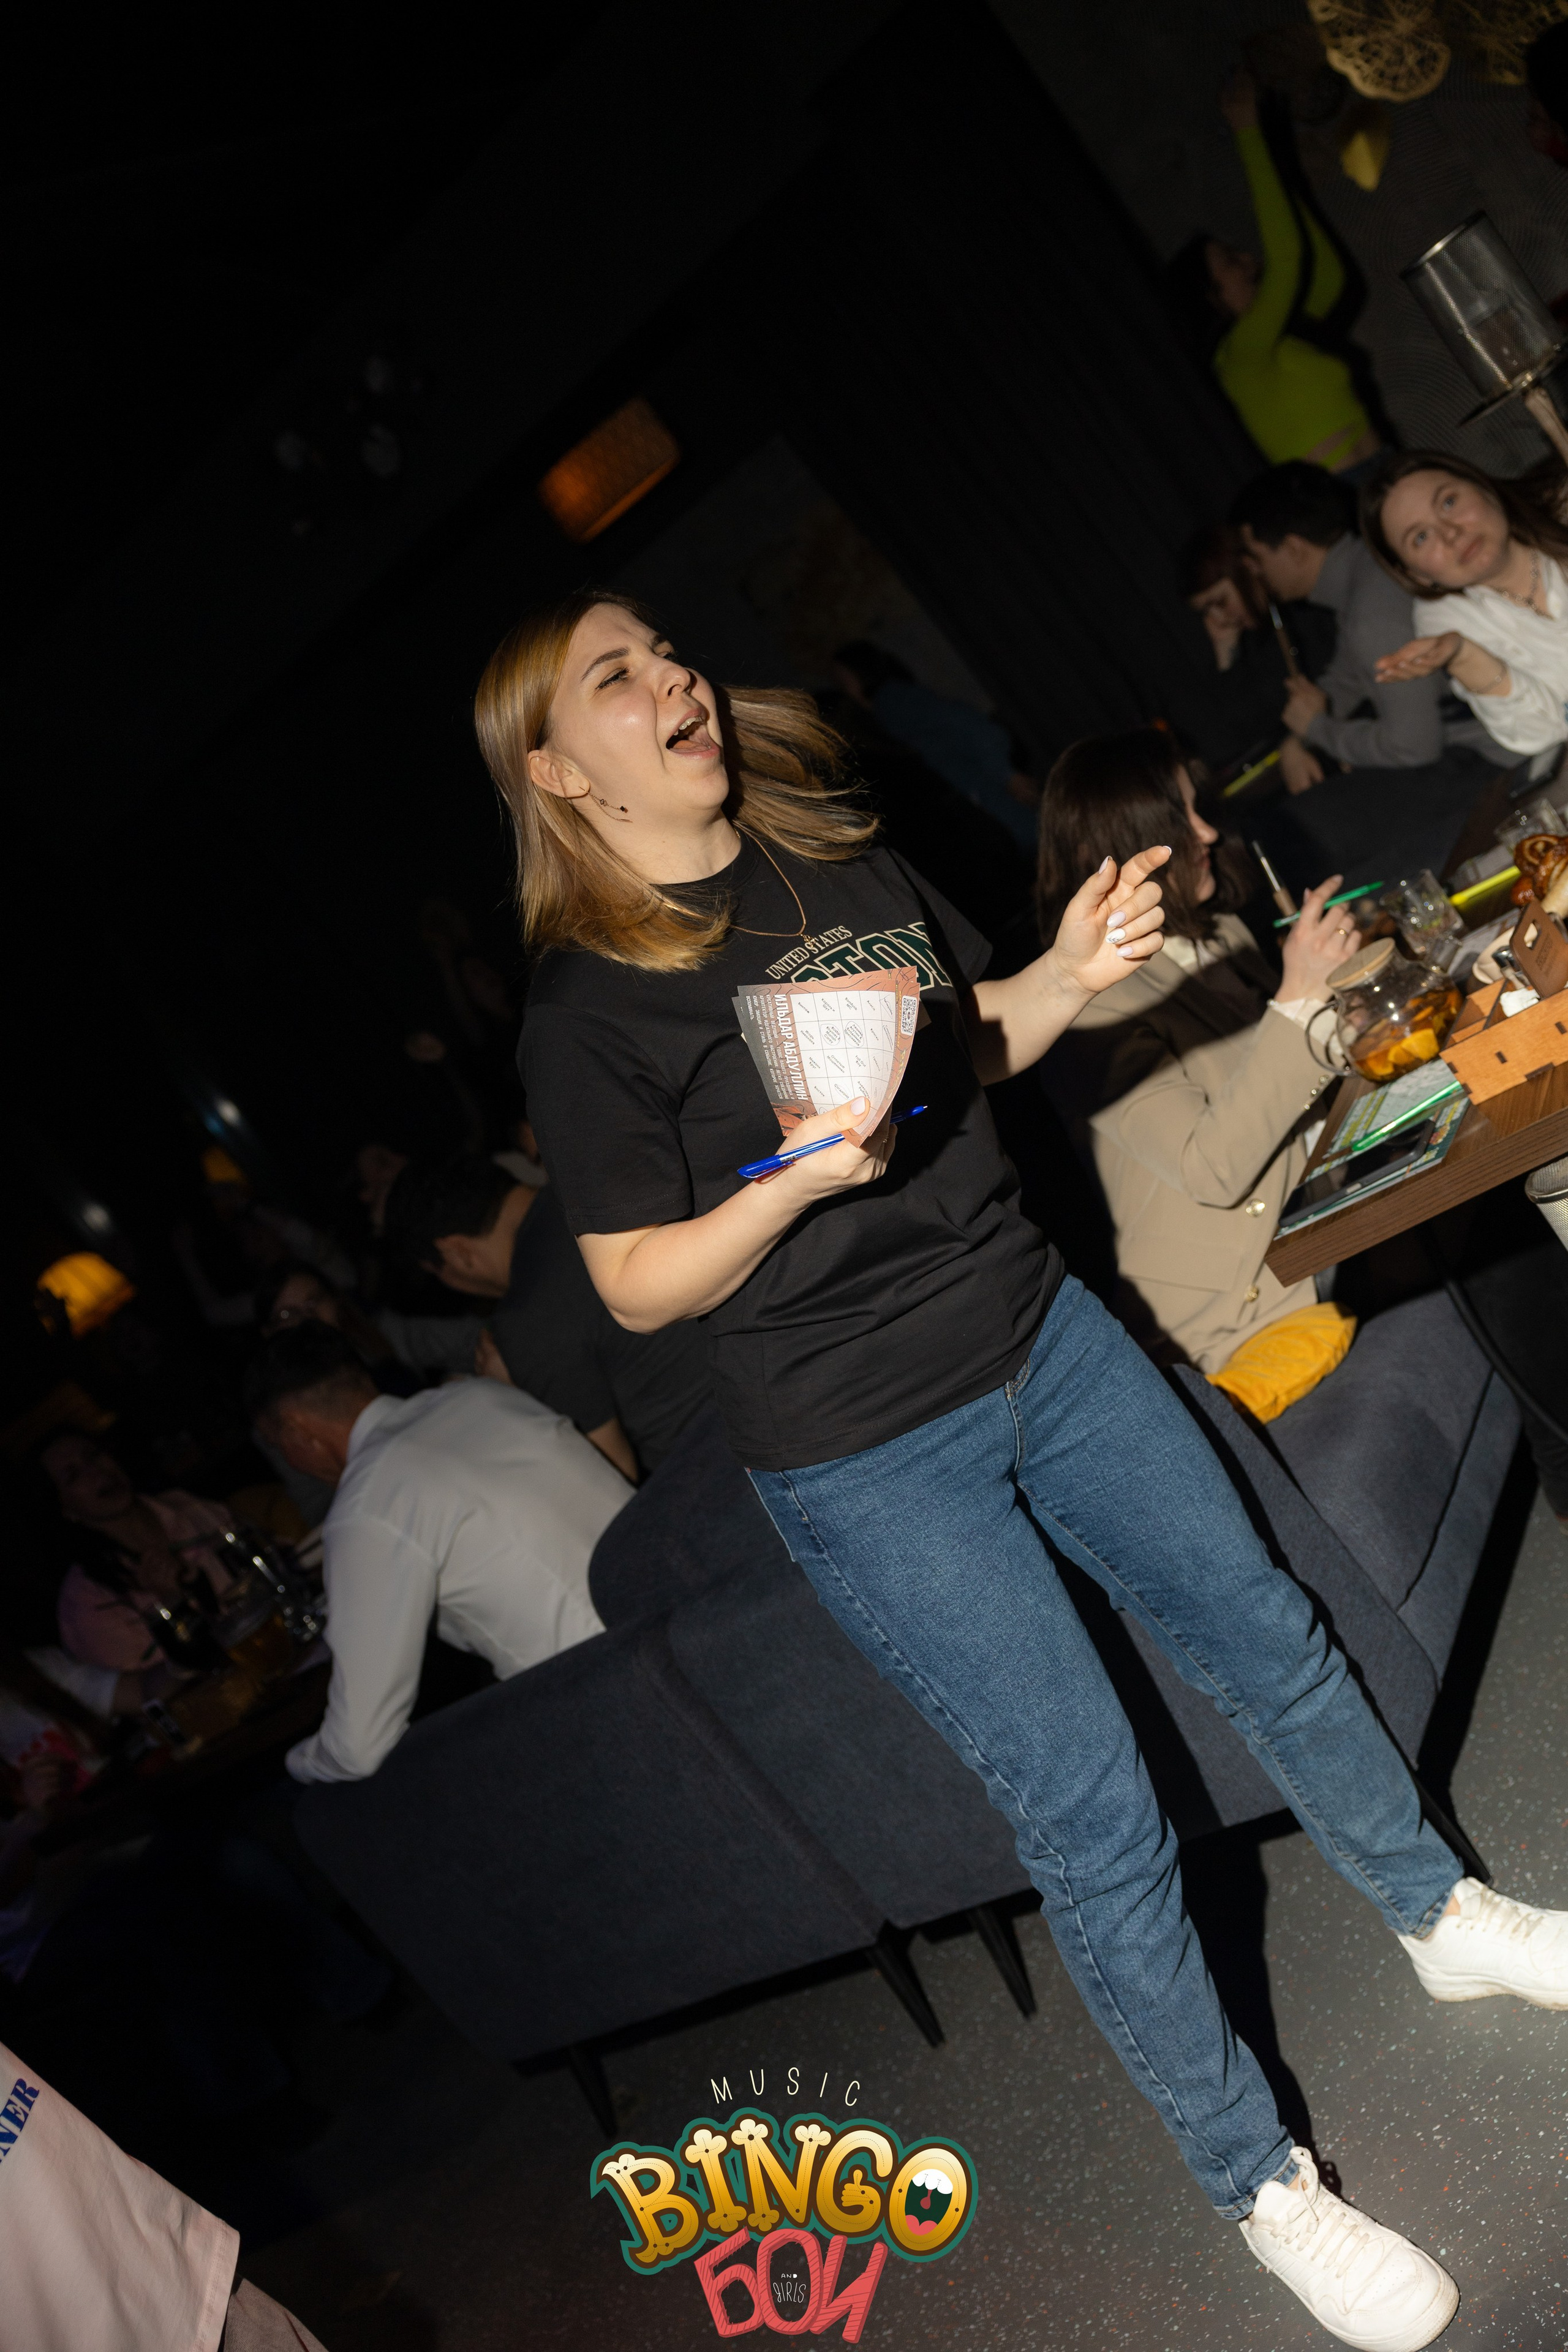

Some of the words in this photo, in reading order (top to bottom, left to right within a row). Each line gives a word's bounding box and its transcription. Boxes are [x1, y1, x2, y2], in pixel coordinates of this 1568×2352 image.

[765, 947, 810, 979] UNITED
[805, 925, 853, 954] STATES
[759, 995, 767, 1019] АРХИТЕКТОР
[764, 1020, 773, 1044] ИДЕАЛЬНОГО
[774, 994, 794, 1039] ИЛЬДАР
[797, 1001, 810, 1013] Винтаж
[805, 1030, 814, 1039] Игорь
[826, 1031, 837, 1042] Mariah
[783, 1041, 809, 1100] АБДУЛЛИН
